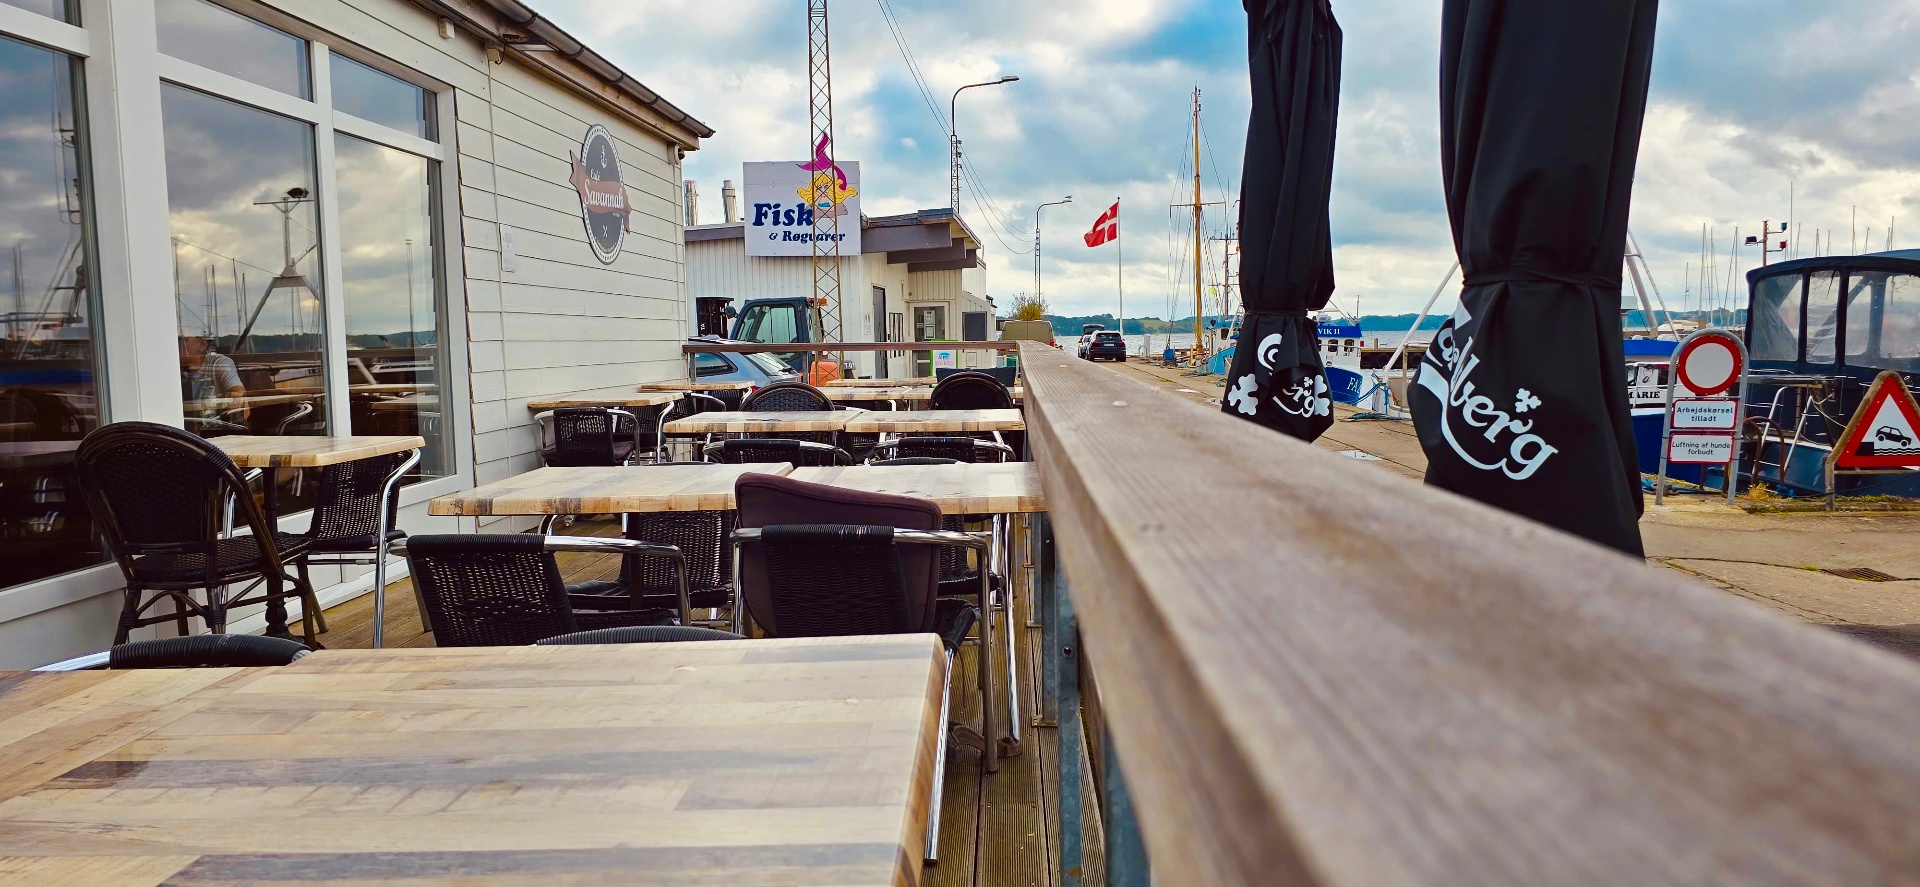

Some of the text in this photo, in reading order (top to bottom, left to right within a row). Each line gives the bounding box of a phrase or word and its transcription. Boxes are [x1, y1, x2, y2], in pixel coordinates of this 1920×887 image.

[584, 178, 624, 209] Savannah
[752, 203, 814, 226] Fisk
[1676, 406, 1734, 415] Arbejdskørsel
[1671, 441, 1700, 449] Luftning
